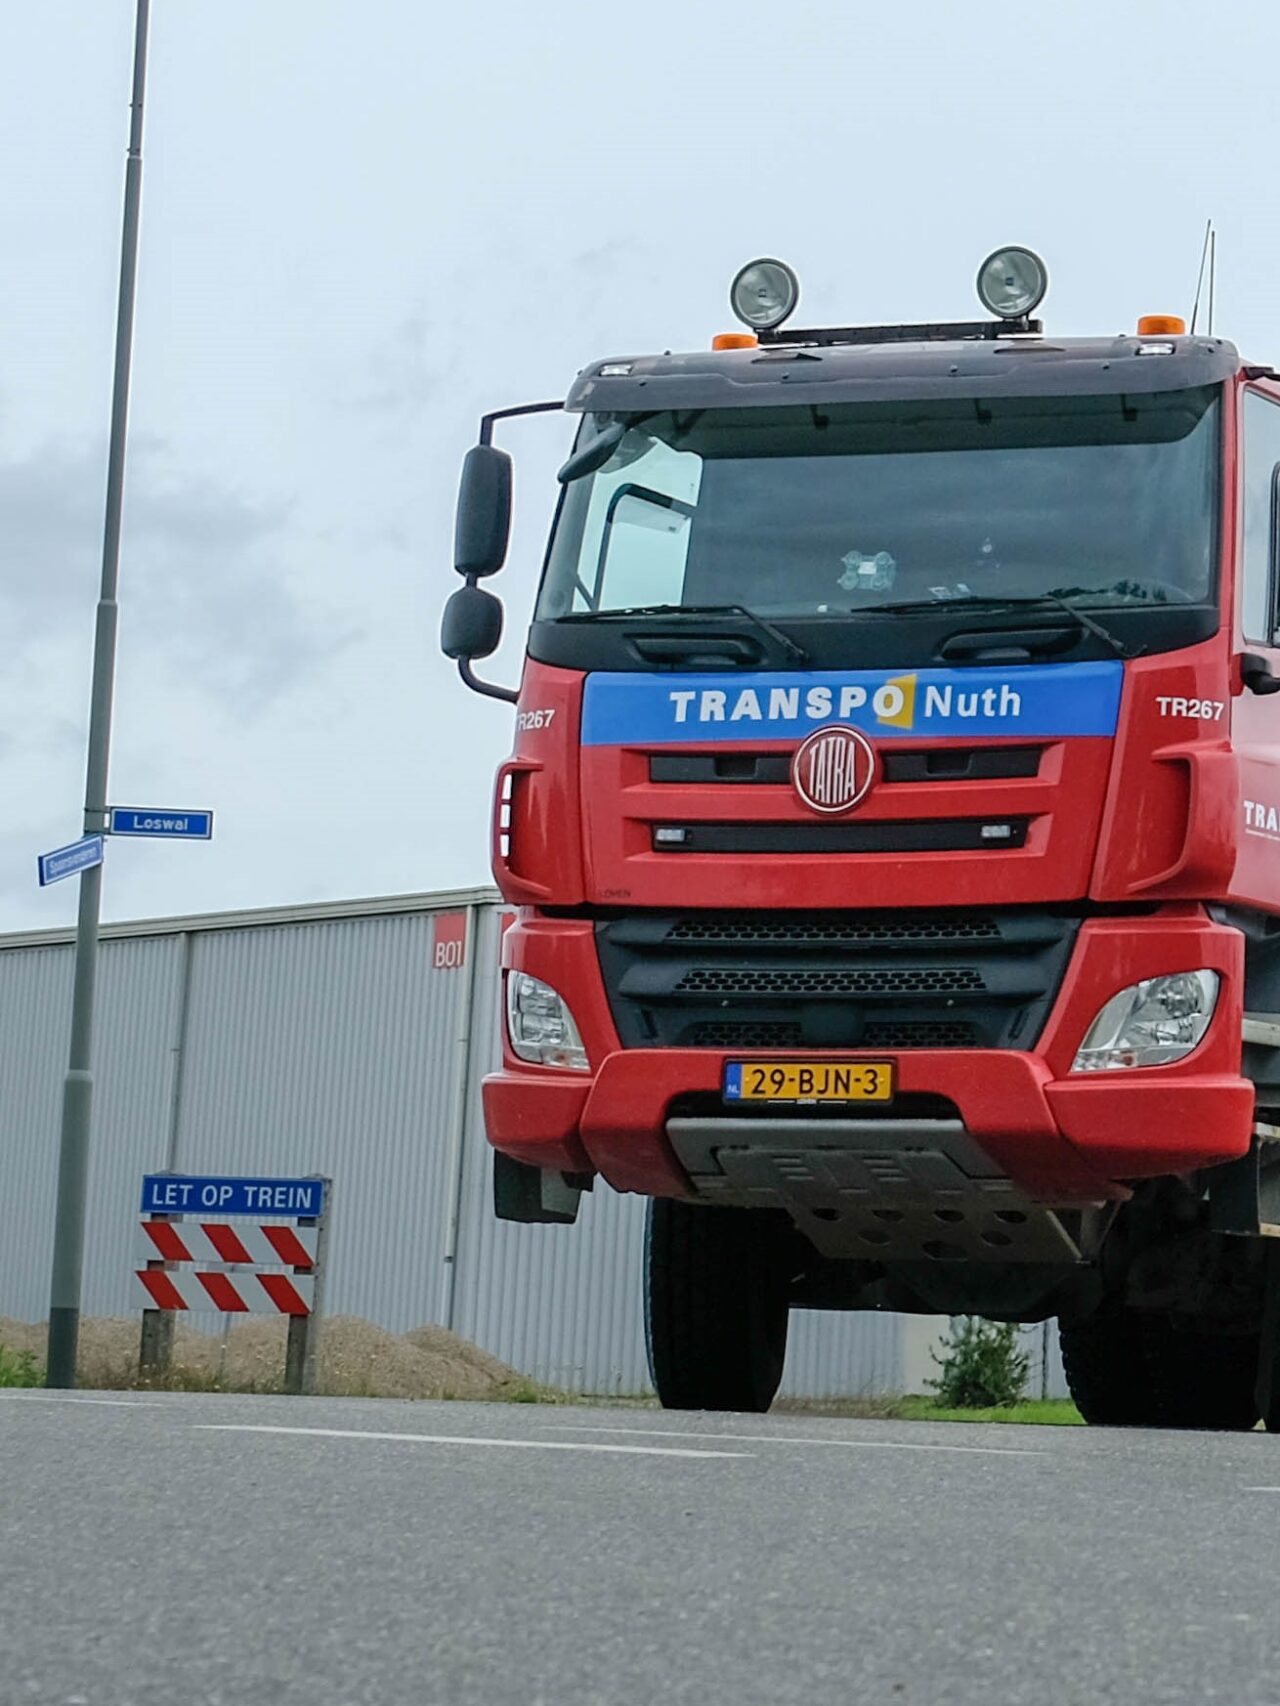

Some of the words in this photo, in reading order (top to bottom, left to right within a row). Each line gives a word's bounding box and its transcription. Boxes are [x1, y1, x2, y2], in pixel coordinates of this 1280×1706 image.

[669, 685, 904, 722] TRANSPO
[924, 684, 1021, 718] Nuth
[1156, 696, 1224, 721] TR267
[809, 736, 856, 804] TATRA
[133, 815, 189, 831] Loswal
[751, 1068, 879, 1095] 29-BJN-3
[152, 1183, 193, 1205] LET
[201, 1184, 234, 1207] OP
[243, 1185, 313, 1209] TREIN
